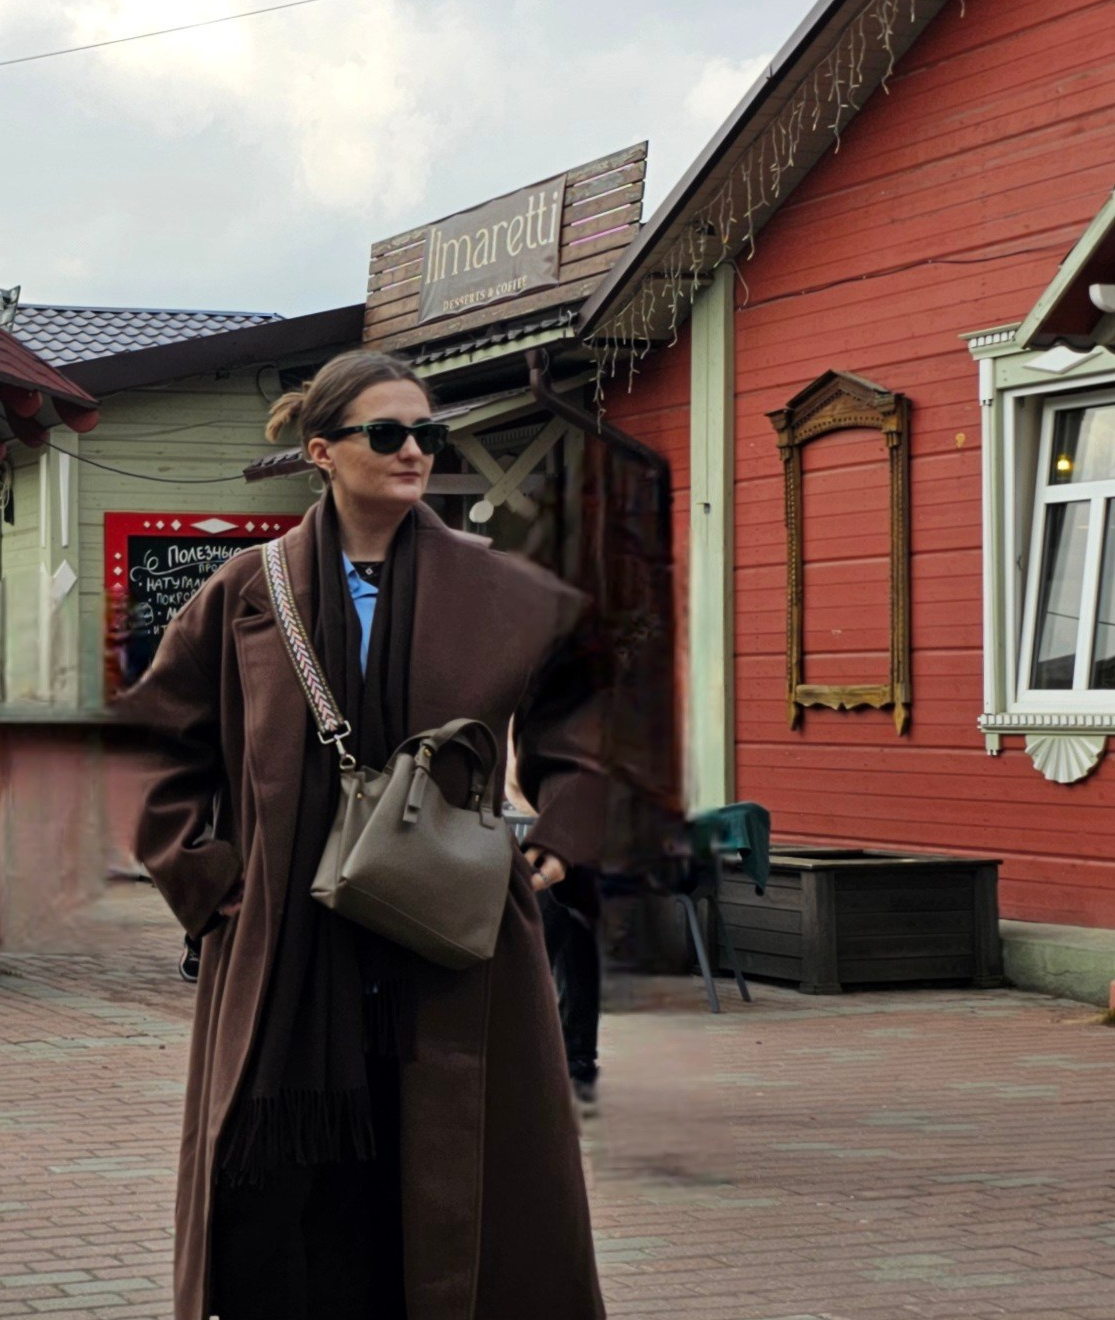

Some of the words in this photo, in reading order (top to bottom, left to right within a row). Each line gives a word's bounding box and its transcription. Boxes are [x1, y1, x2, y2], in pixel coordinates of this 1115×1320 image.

[425, 191, 558, 284] Ilmaretti
[443, 291, 485, 311] DESSERTS
[487, 287, 494, 298] &
[495, 276, 527, 296] COFFEE
[198, 563, 221, 574] ПРО
